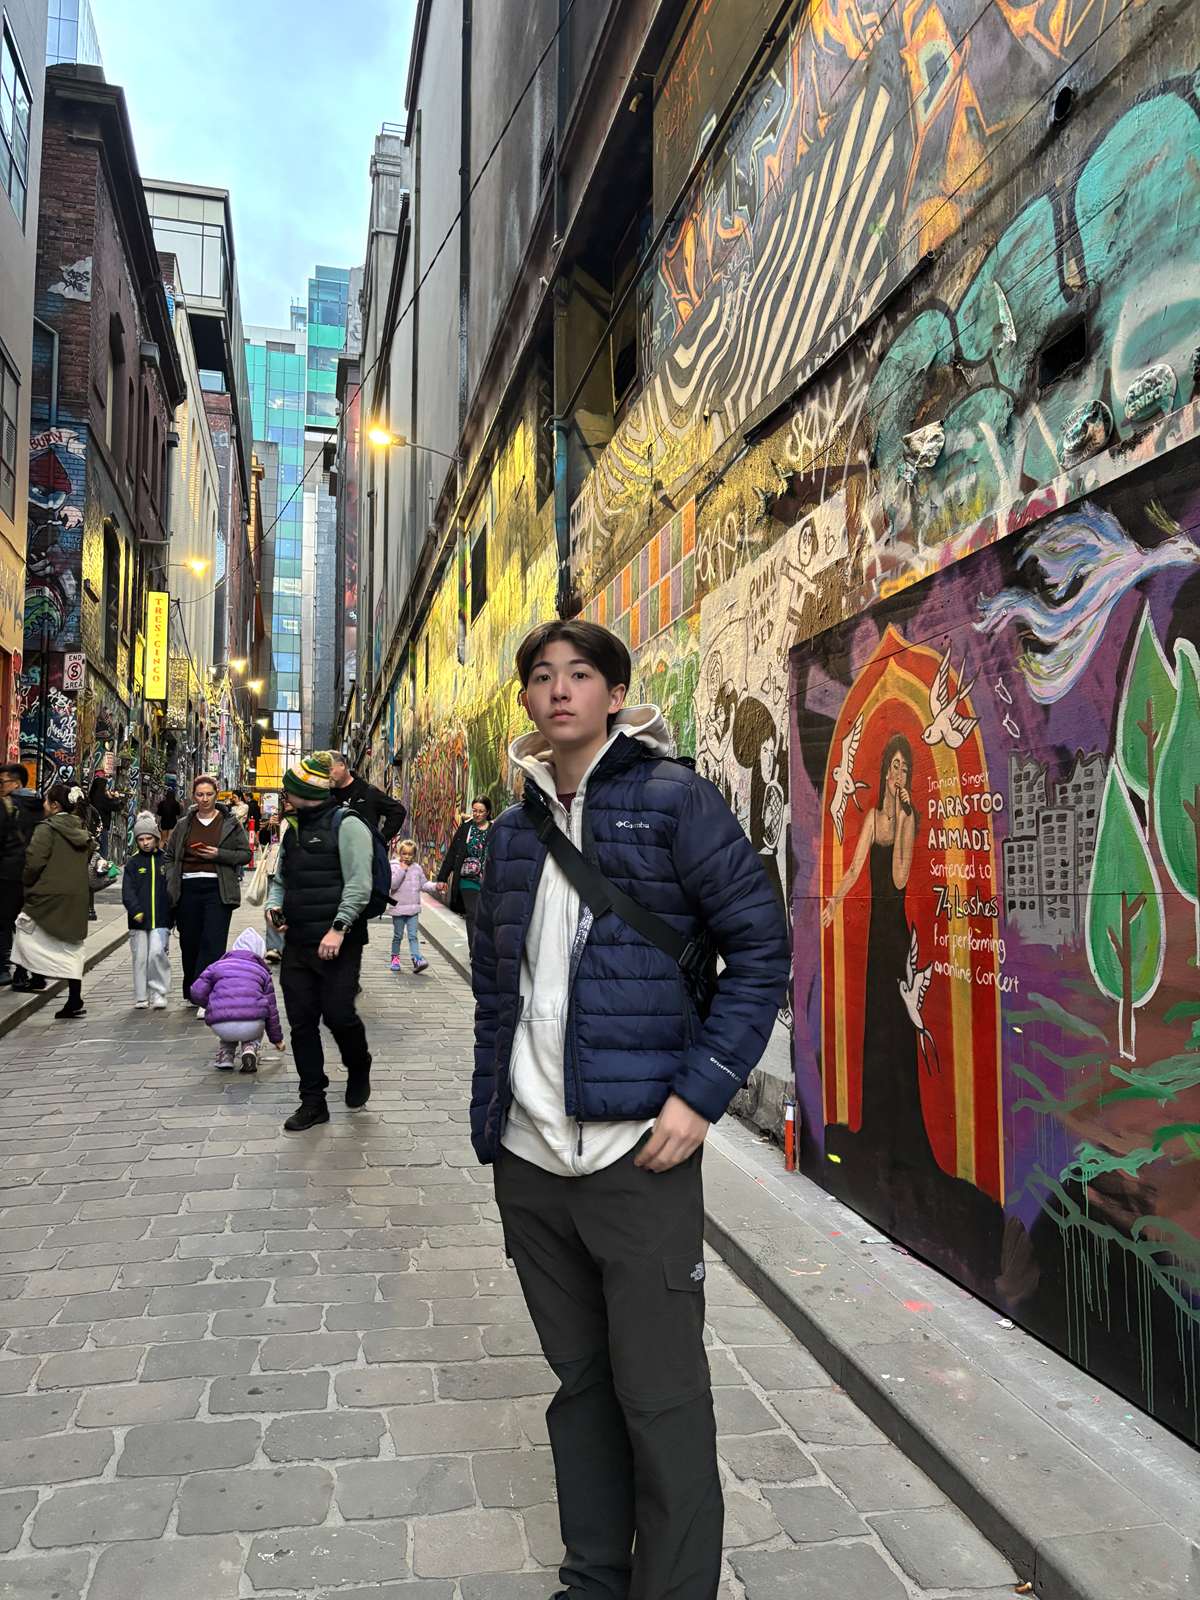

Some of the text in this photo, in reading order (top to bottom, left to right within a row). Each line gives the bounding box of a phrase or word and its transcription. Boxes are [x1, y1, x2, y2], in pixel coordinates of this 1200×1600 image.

[750, 557, 777, 608] PUNK
[152, 598, 164, 683] TRES CINCO
[754, 619, 774, 655] DED
[68, 654, 82, 662] END
[928, 792, 1004, 820] PARASTOO
[928, 827, 991, 851] AHMADI
[930, 853, 993, 880] Sentenced to
[933, 885, 999, 919] 74 Lashes
[952, 927, 1006, 964] performing
